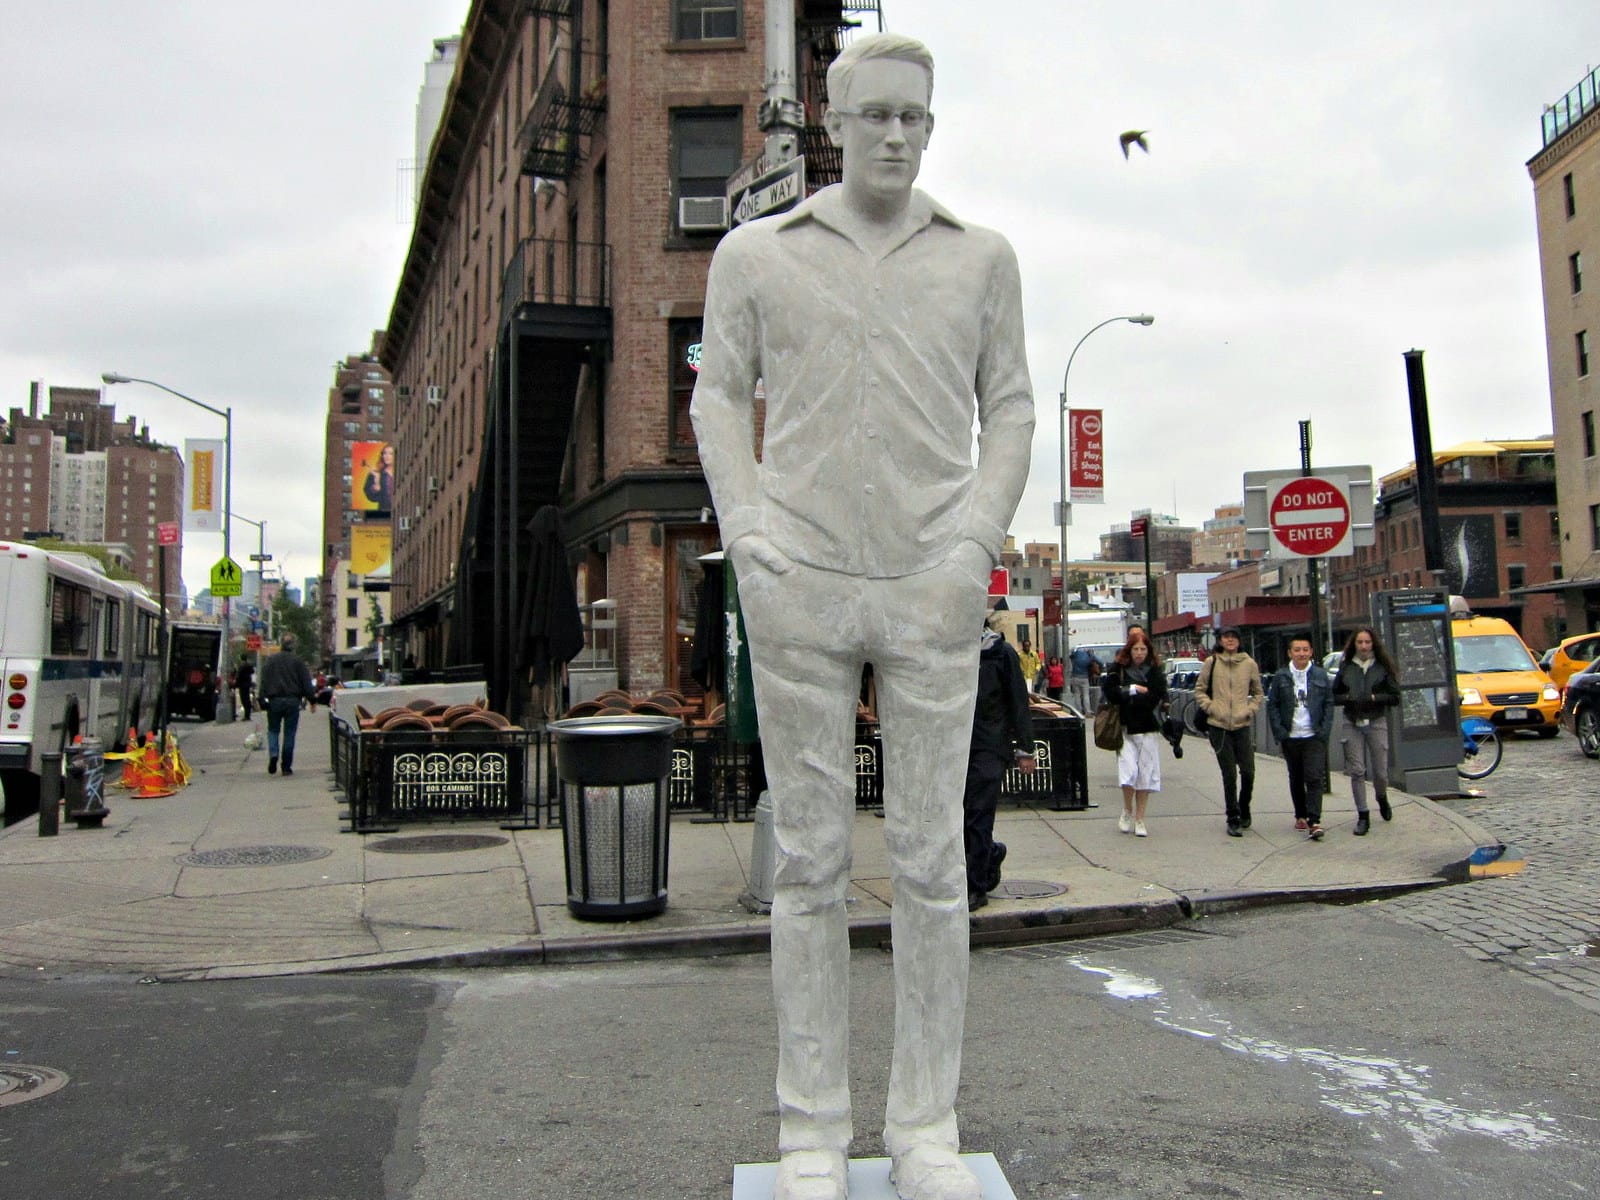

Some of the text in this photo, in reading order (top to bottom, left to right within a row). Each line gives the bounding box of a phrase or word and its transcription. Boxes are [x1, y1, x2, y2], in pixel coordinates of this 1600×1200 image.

[740, 194, 760, 219] ONE
[769, 175, 792, 205] WAY
[1282, 491, 1334, 507] DO NOT
[1288, 527, 1334, 542] ENTER
[442, 784, 474, 792] CAMINOS
